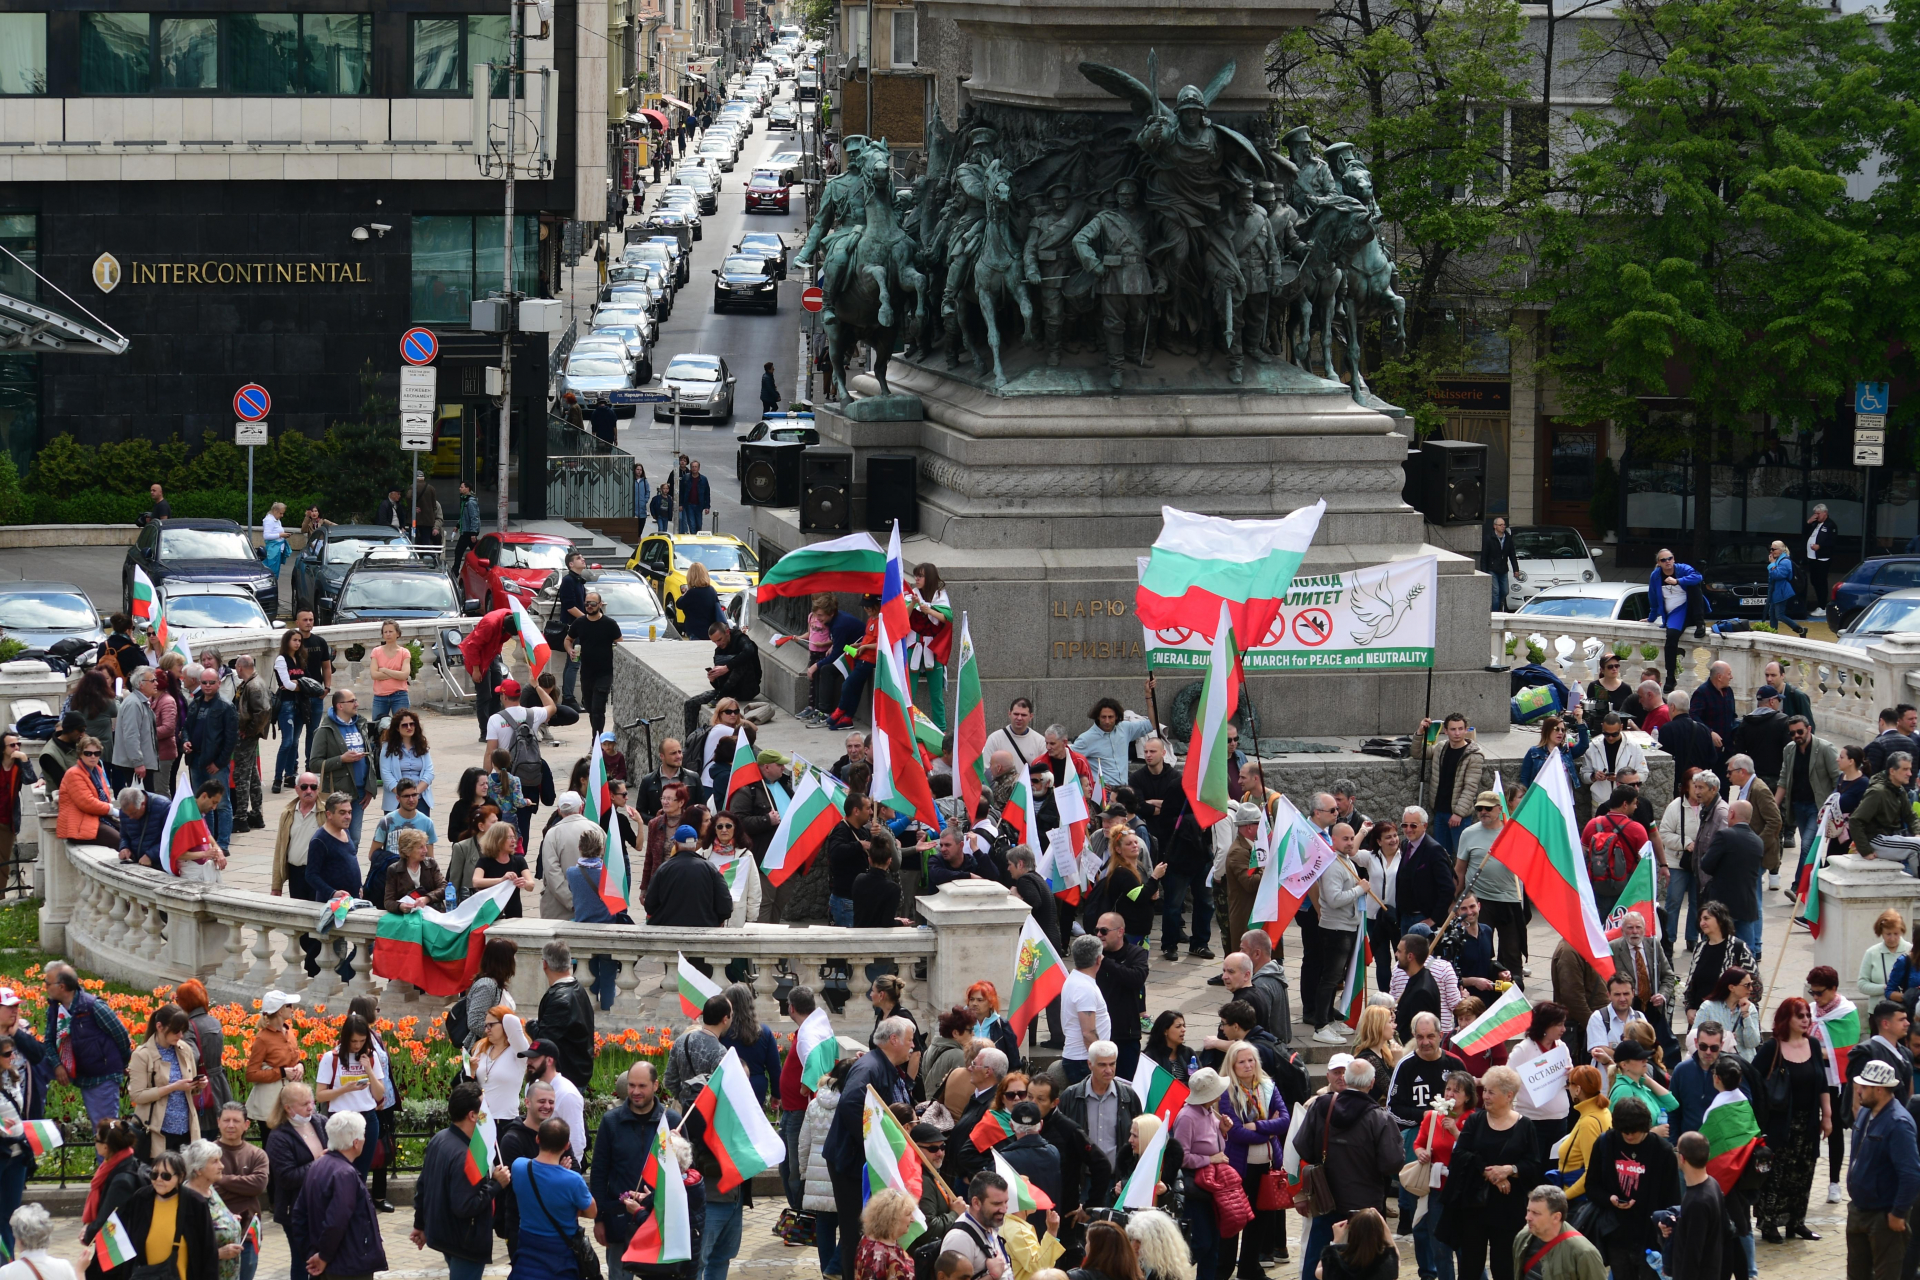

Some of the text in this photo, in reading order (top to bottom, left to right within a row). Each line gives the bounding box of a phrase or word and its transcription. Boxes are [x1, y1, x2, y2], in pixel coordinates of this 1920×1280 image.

[1427, 389, 1483, 399] Patisserie
[1053, 600, 1125, 620] ЦАРЮ
[1053, 641, 1142, 658] ПРИЗНА
[1153, 652, 1190, 665] ENERAL
[1253, 655, 1289, 667] MARCH
[1291, 655, 1307, 666] for
[1309, 654, 1342, 666] PEACE
[1344, 653, 1364, 665] and
[1365, 651, 1428, 664] NEUTRALITY
[1528, 1059, 1566, 1084] ОСТАВКА!
